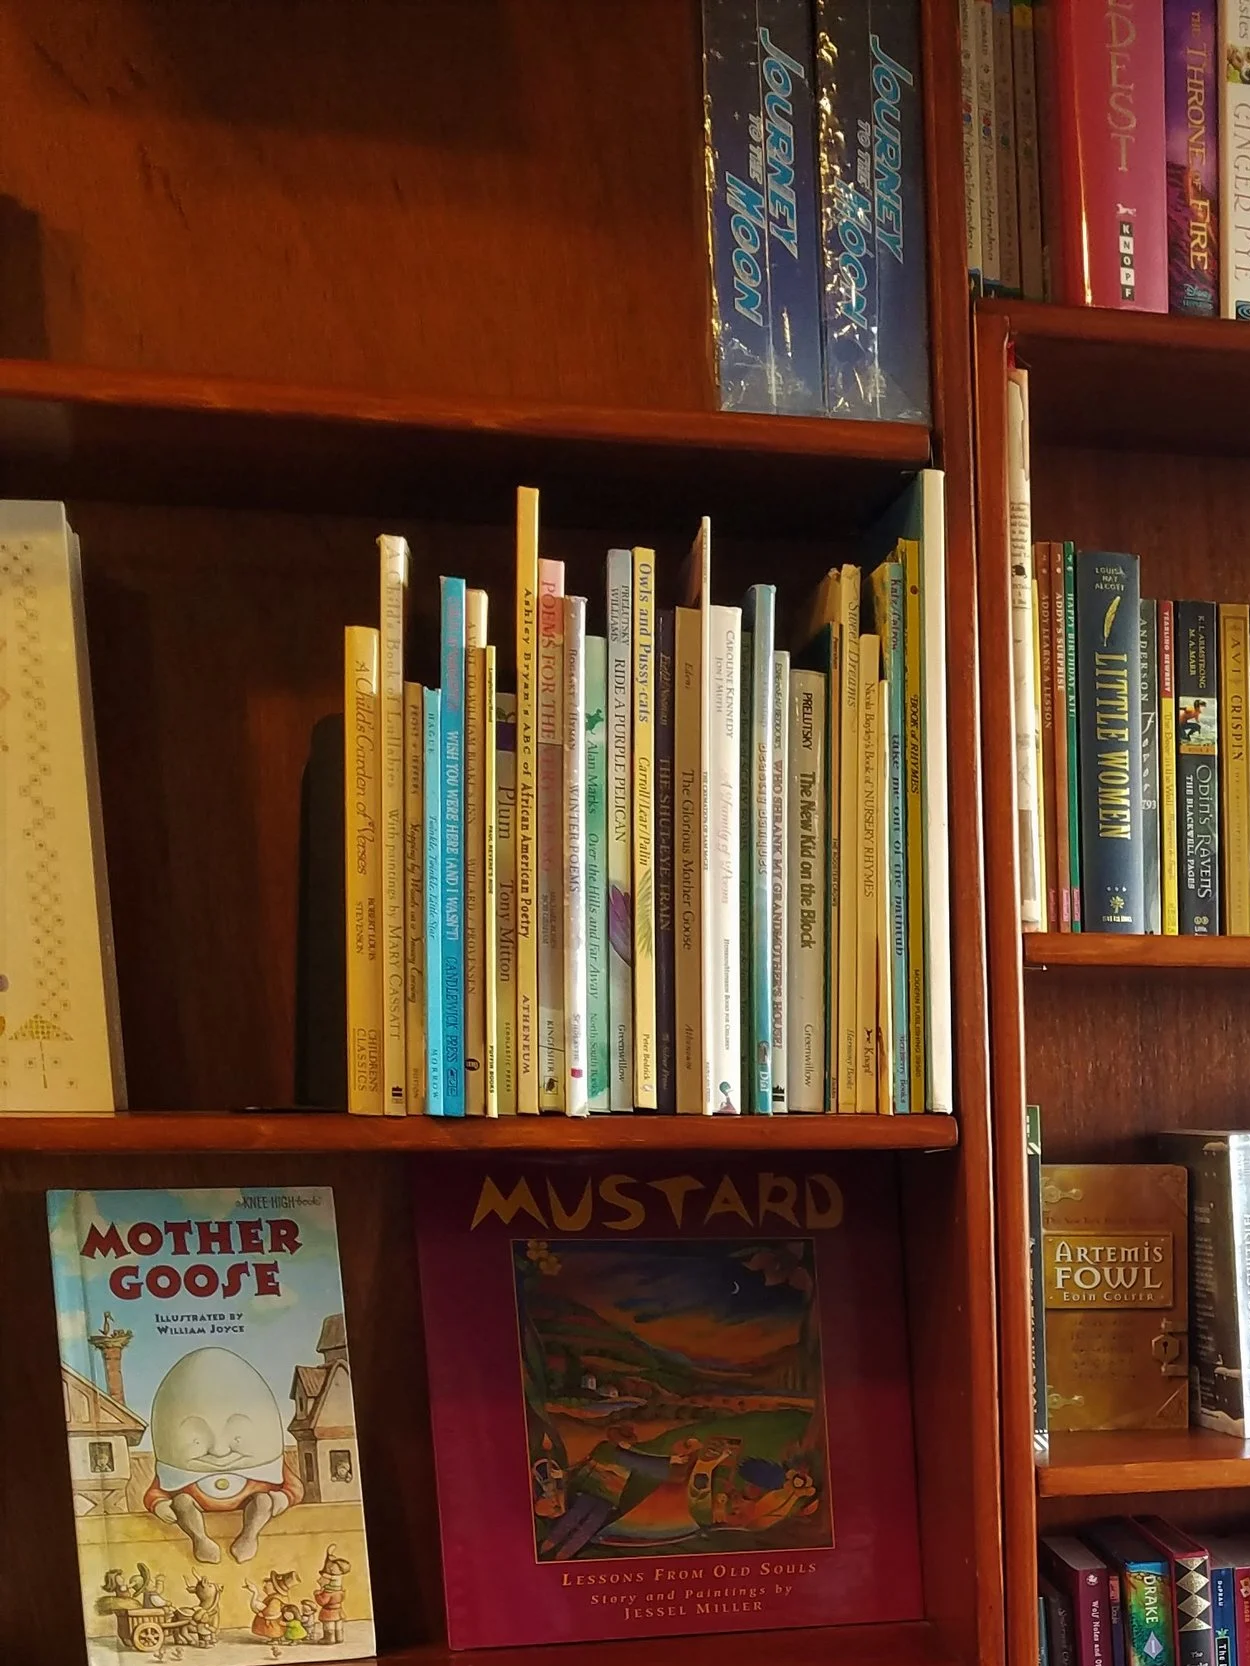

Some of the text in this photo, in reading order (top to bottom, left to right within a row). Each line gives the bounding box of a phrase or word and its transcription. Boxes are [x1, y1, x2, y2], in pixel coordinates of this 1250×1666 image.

[1185, 47, 1207, 166] THRONE
[758, 27, 803, 259] JOURNEY
[870, 34, 914, 262] JOURNEY
[725, 171, 767, 327] MOON
[1188, 199, 1211, 271] FIRE
[1119, 221, 1135, 301] KNOPF
[521, 588, 532, 755] Ashley Bryan's ABC
[1231, 639, 1241, 673] AVI
[1095, 652, 1129, 742] LITTLE
[801, 692, 813, 750] PRELUTSKY
[800, 802, 816, 833] New
[1097, 750, 1131, 840] WOMEN
[800, 834, 816, 859] Kid
[800, 881, 815, 907] the
[499, 880, 514, 983] Tony Mitton
[519, 898, 532, 938] Poetry
[800, 910, 816, 949] Block
[521, 995, 531, 1074] ATHENEUM
[469, 1171, 846, 1232] MUSTARD
[79, 1218, 304, 1261] MOTHER
[108, 1260, 283, 1300] GOOSE
[1054, 1267, 1163, 1290] FOWL
[154, 1312, 244, 1323] ILLUSTRATED BY
[157, 1323, 245, 1336] WILLIAM JOYCE
[562, 1562, 817, 1587] LESSONS FROM OLD SOULS
[591, 1583, 793, 1606] Story and Paintings by
[624, 1601, 763, 1620] JESSEL MILLER
[1143, 1575, 1159, 1625] DRAKE
